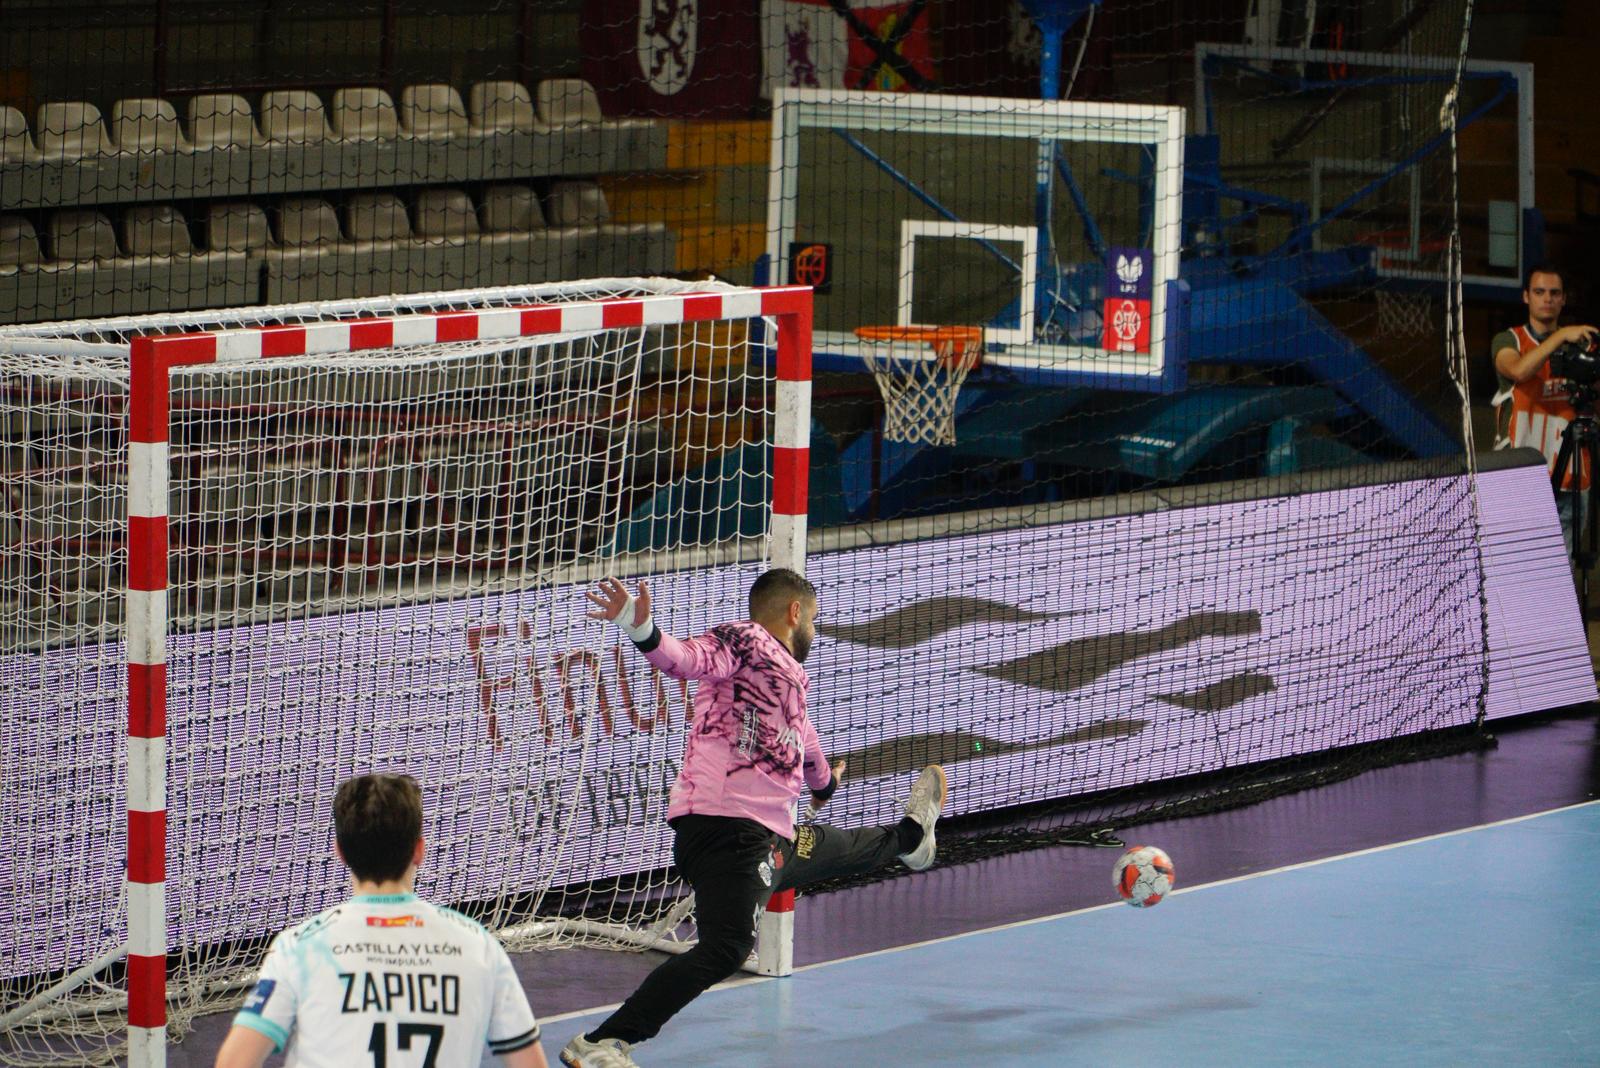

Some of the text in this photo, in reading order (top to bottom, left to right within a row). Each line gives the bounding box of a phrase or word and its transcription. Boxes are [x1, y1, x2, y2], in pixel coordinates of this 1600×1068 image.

[332, 942, 462, 957] CASTILLA Y LEÓN
[338, 971, 460, 1016] ZAPICO
[367, 1022, 444, 1068] 17
